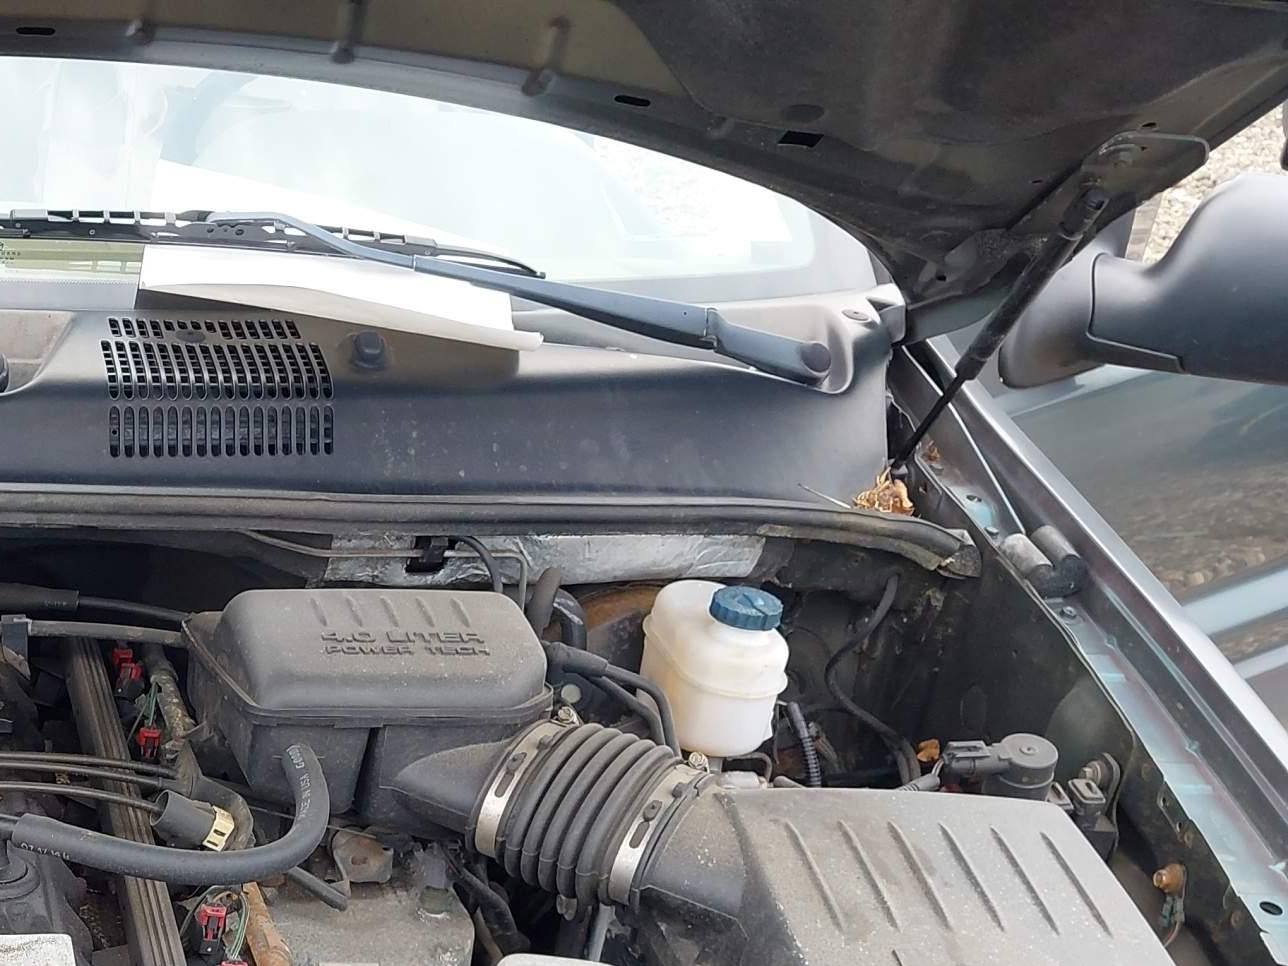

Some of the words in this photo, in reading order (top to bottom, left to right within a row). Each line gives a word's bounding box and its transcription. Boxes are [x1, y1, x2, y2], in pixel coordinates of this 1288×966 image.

[320, 631, 377, 644] 4.0
[385, 631, 485, 644] LITER
[324, 645, 415, 657] POWER
[424, 645, 491, 657] TECH
